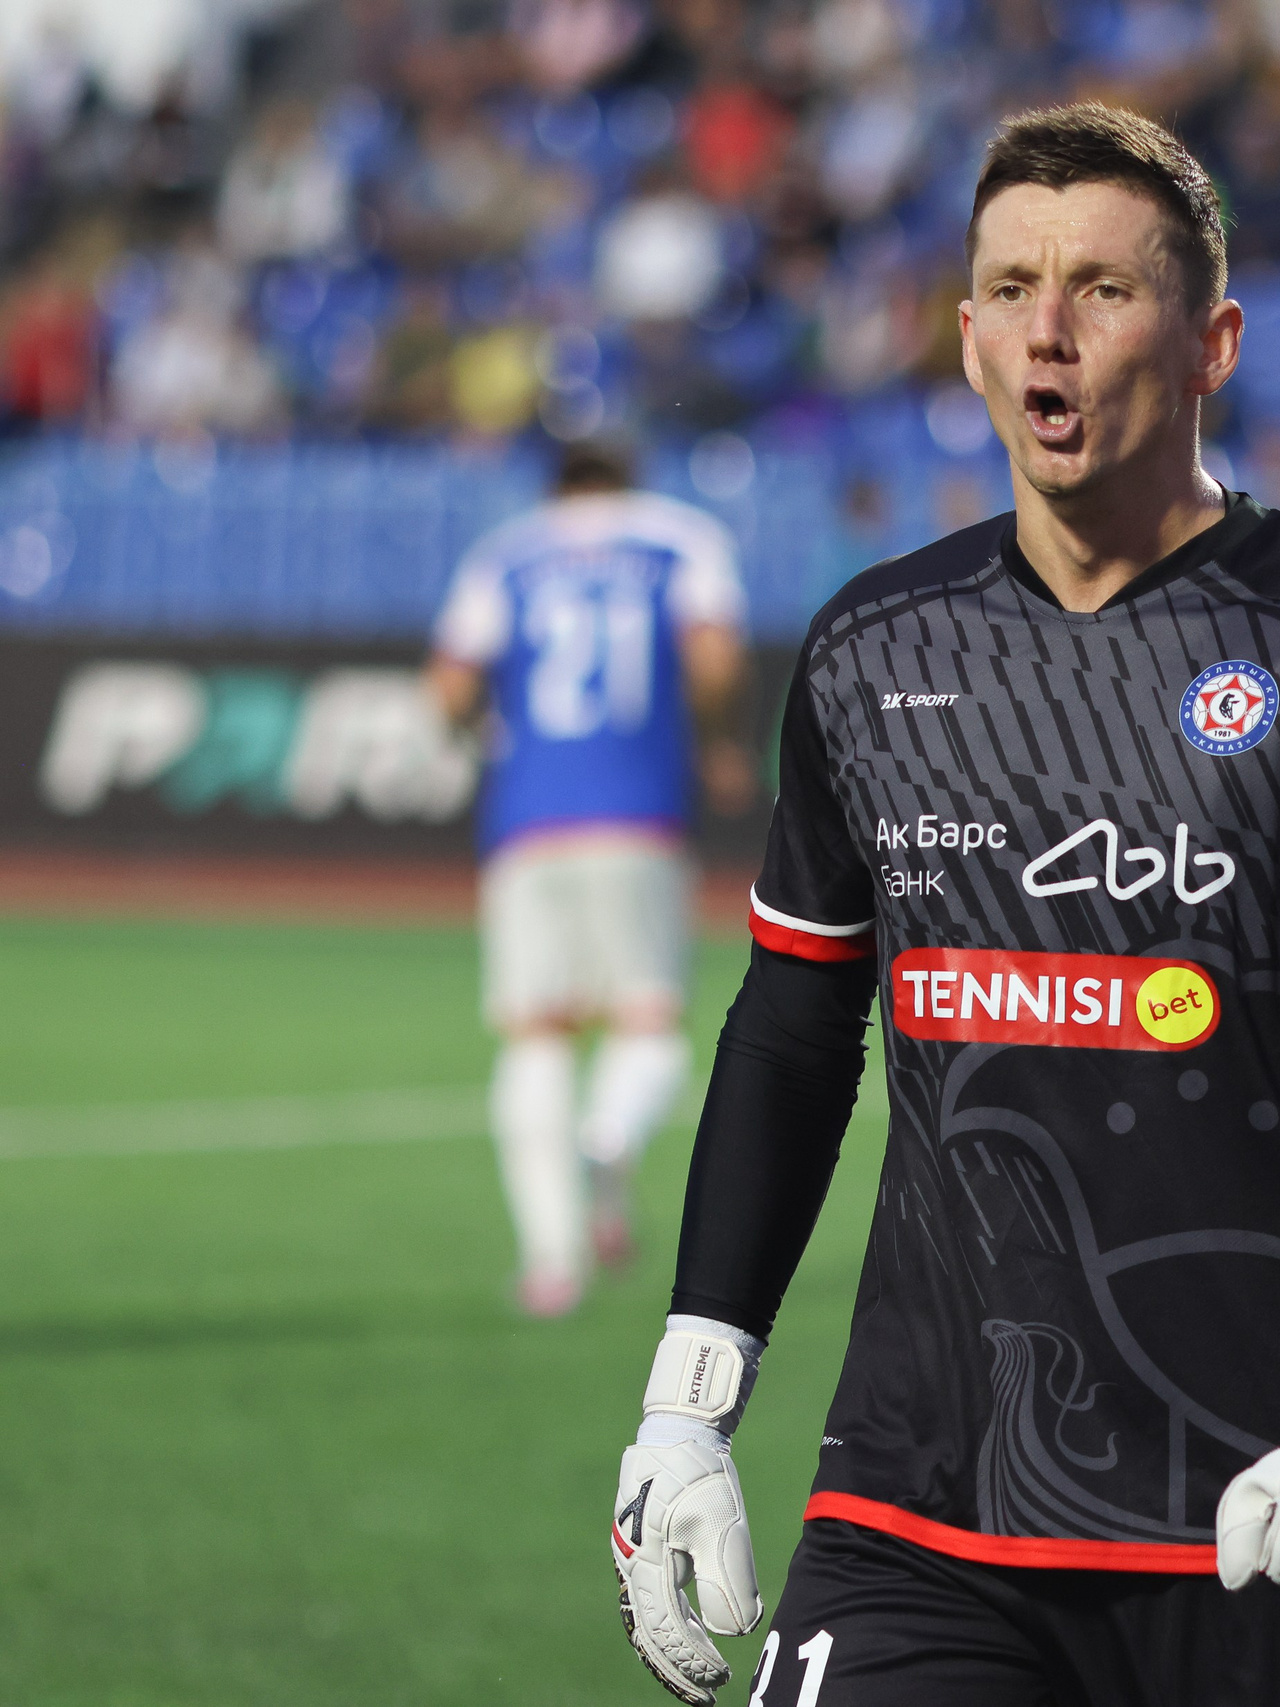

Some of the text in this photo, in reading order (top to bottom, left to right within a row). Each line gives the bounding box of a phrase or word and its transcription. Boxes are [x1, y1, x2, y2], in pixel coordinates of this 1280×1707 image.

[905, 694, 959, 707] SPORT
[1214, 730, 1231, 738] 1981
[876, 814, 1007, 856] Ак Барс
[902, 970, 1203, 1027] TENNISI bet
[688, 1344, 711, 1404] EXTREME
